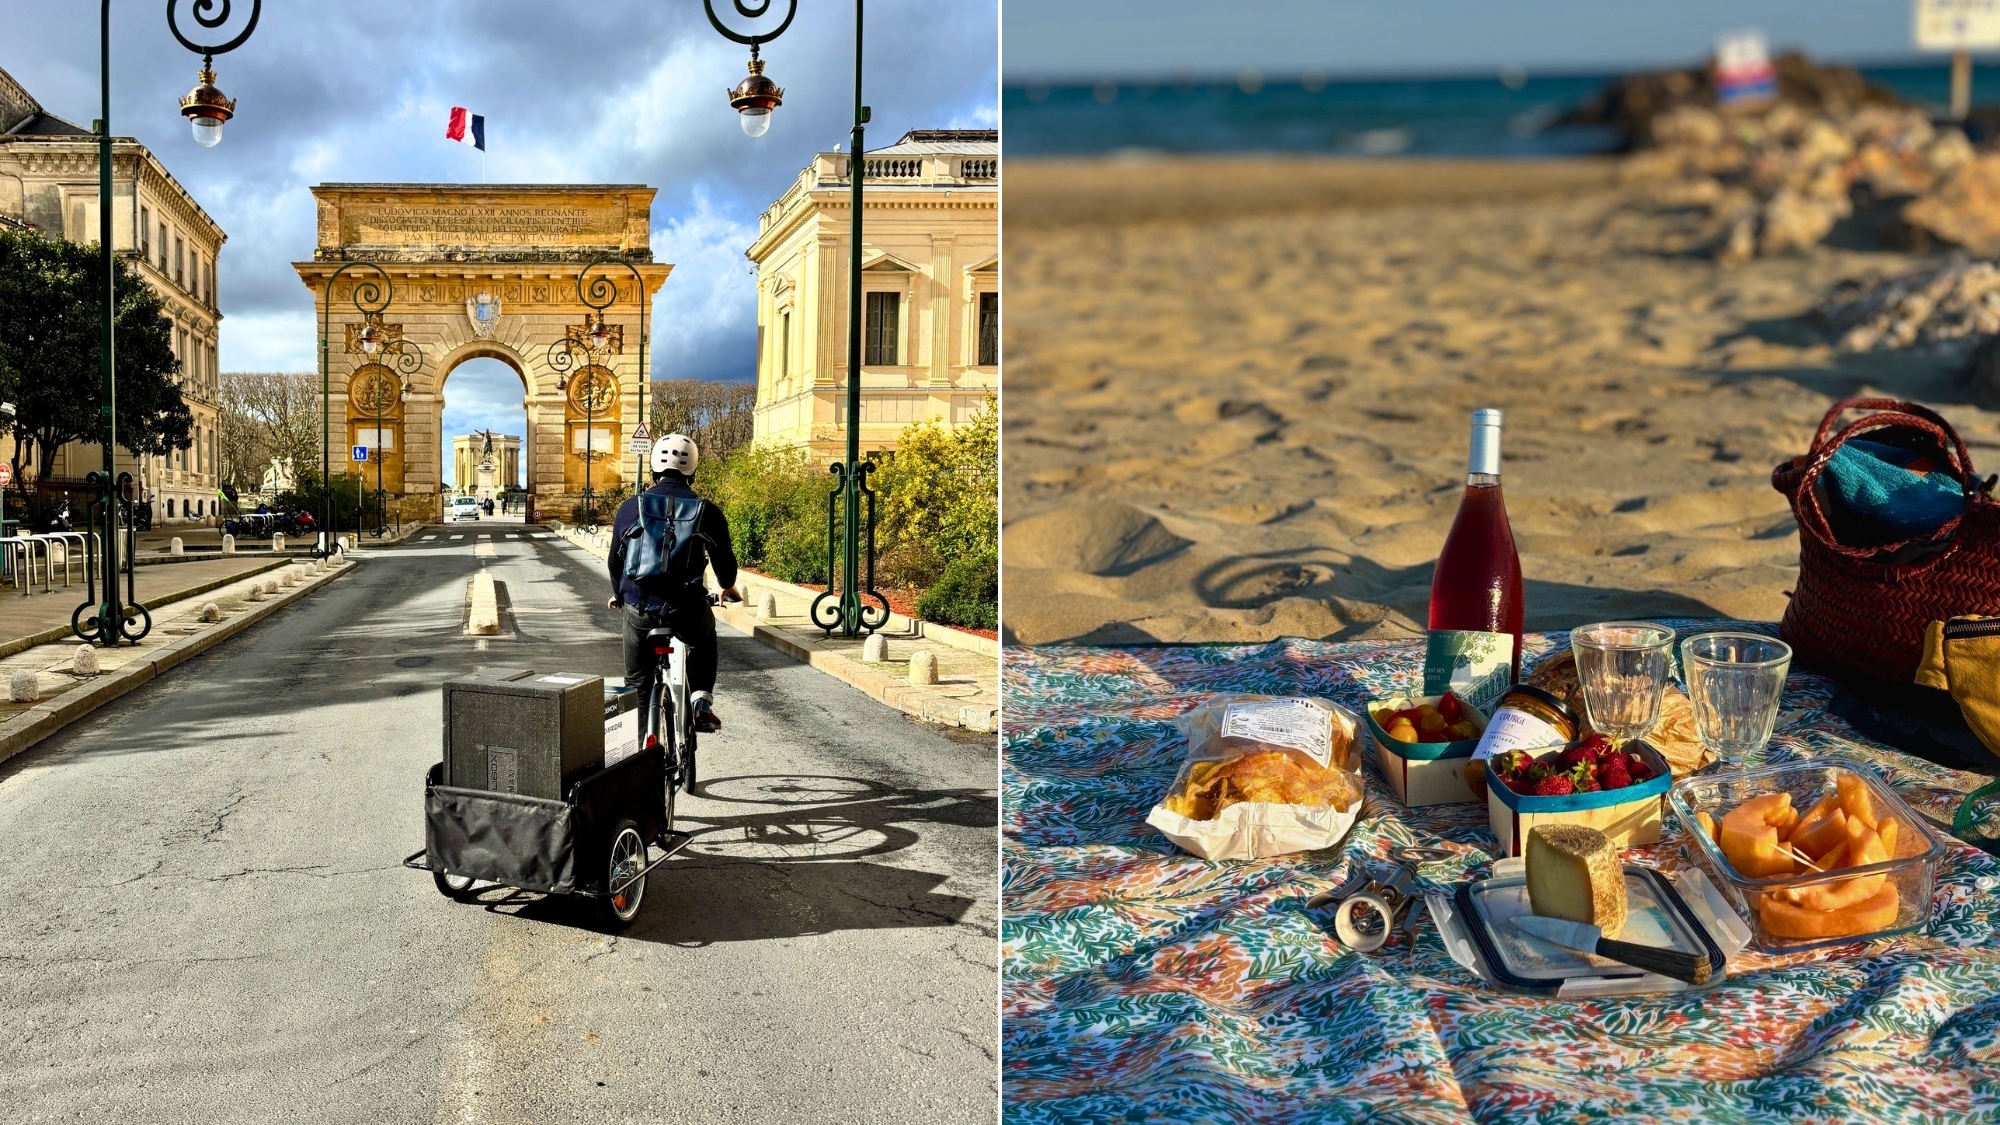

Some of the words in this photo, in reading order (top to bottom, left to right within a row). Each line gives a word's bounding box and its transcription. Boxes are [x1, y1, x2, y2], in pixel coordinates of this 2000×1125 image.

[378, 208, 428, 216] LUDOVICO
[432, 208, 468, 216] MAGNO
[471, 208, 495, 217] LXXII
[499, 208, 531, 217] ANNOS
[534, 208, 588, 217] REGNANTE
[543, 217, 594, 225] GENTIBUS
[404, 232, 424, 241] PAX
[429, 232, 461, 241] TERRA
